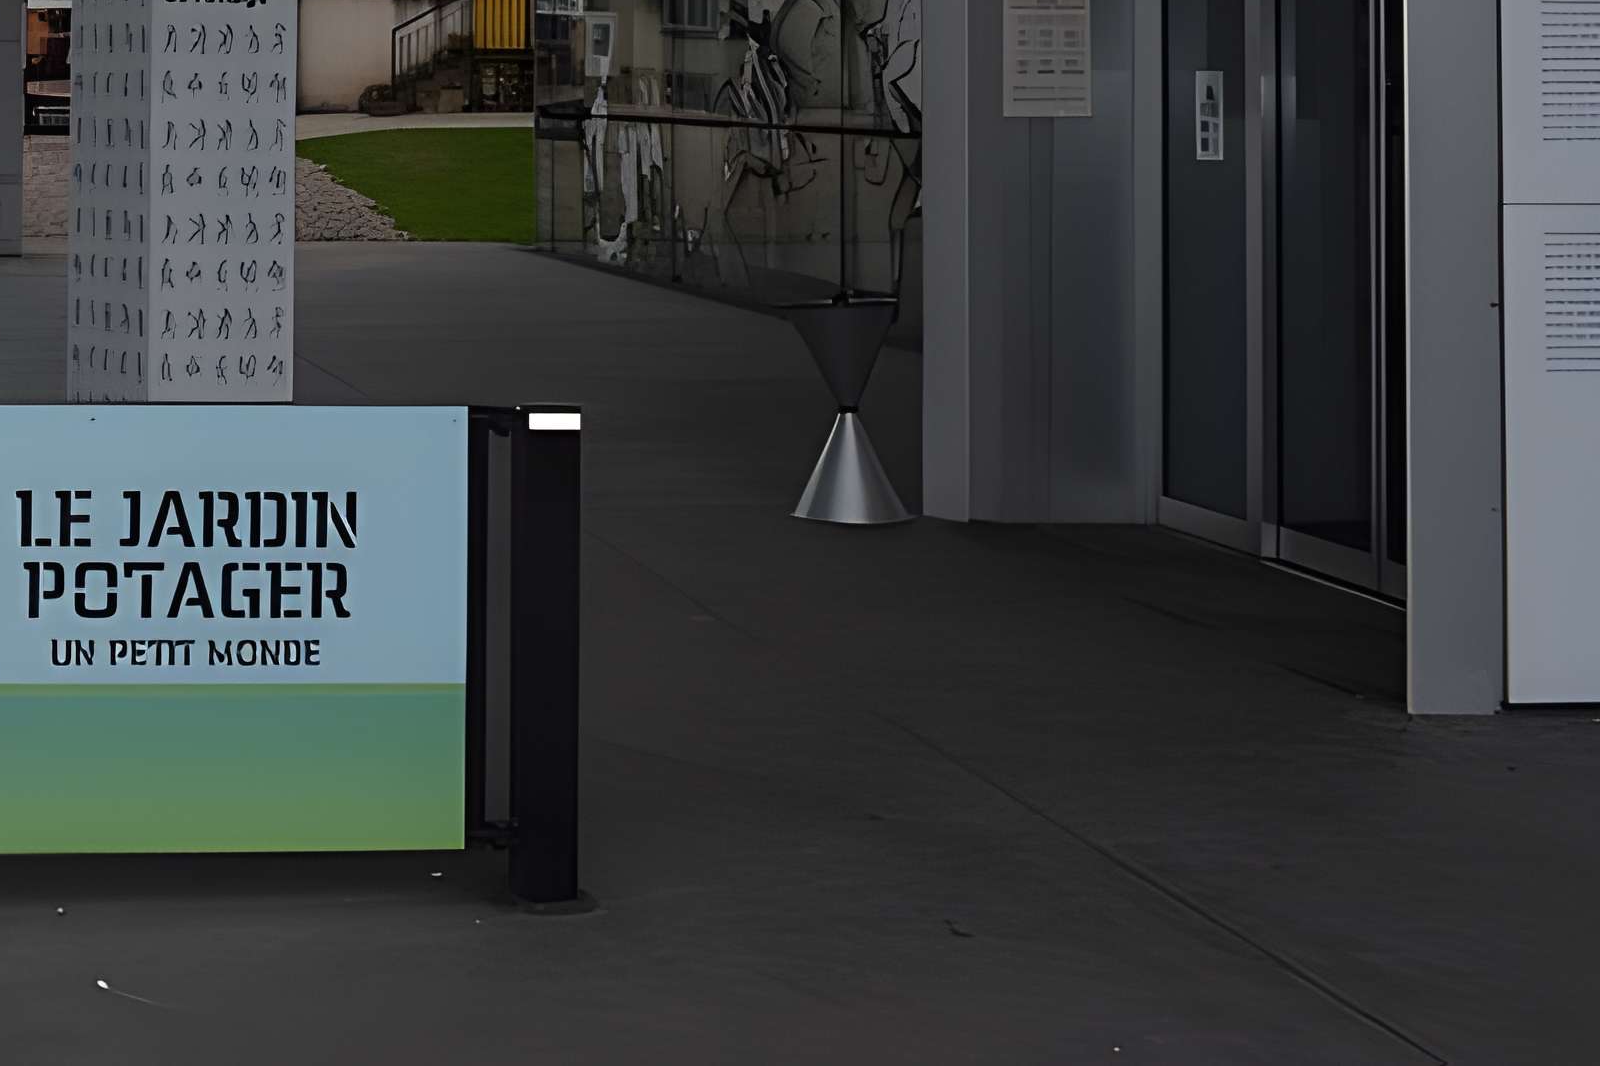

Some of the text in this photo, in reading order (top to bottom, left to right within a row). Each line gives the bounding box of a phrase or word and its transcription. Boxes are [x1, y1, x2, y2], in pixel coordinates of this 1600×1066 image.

[16, 491, 356, 548] LE JARDIN
[24, 562, 350, 618] POTAGER
[52, 639, 320, 666] UN PETIT MONDE
